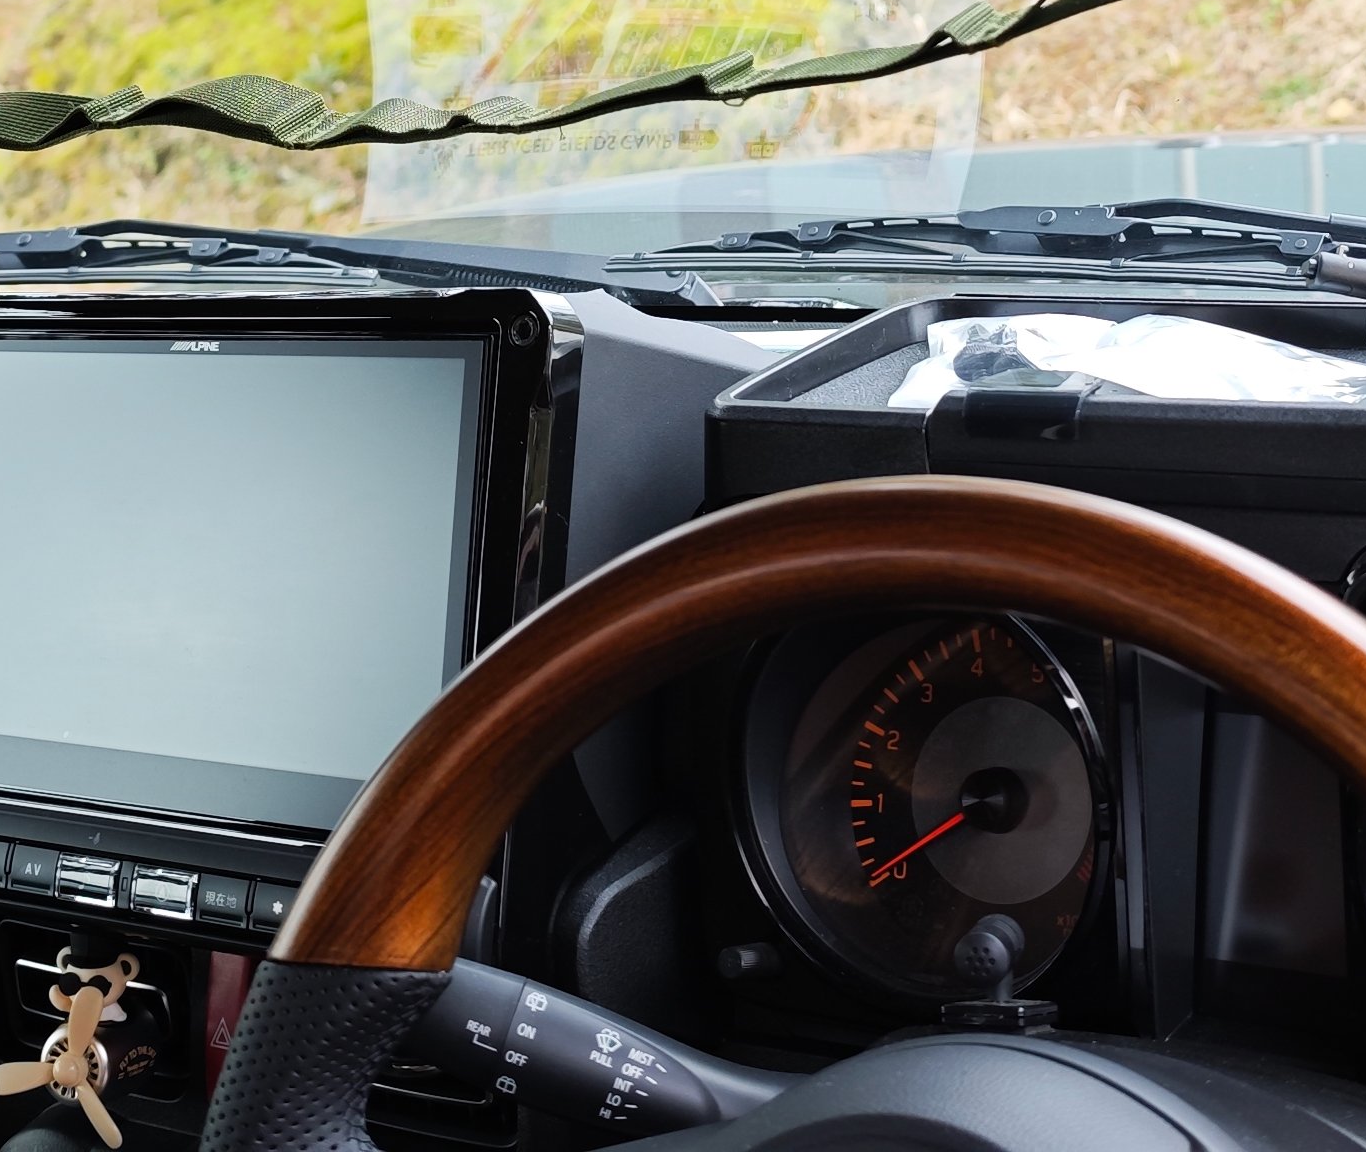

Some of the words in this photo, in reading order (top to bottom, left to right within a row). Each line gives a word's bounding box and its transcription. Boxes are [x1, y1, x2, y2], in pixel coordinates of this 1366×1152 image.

[970, 657, 985, 678] 4
[1031, 664, 1045, 684] 5
[921, 682, 933, 704] 3
[886, 730, 900, 751] 2
[876, 793, 884, 814] 1
[24, 863, 41, 876] AV
[893, 860, 907, 880] 0
[204, 890, 238, 909] 現在地
[466, 1019, 492, 1038] REAR
[517, 1022, 537, 1040] ON
[505, 1050, 529, 1067] OFF
[589, 1050, 613, 1068] PULL
[628, 1047, 656, 1067] MIST
[621, 1063, 645, 1080] OFF
[612, 1077, 634, 1093] INT
[606, 1092, 622, 1107] LO
[599, 1107, 612, 1119] HI
